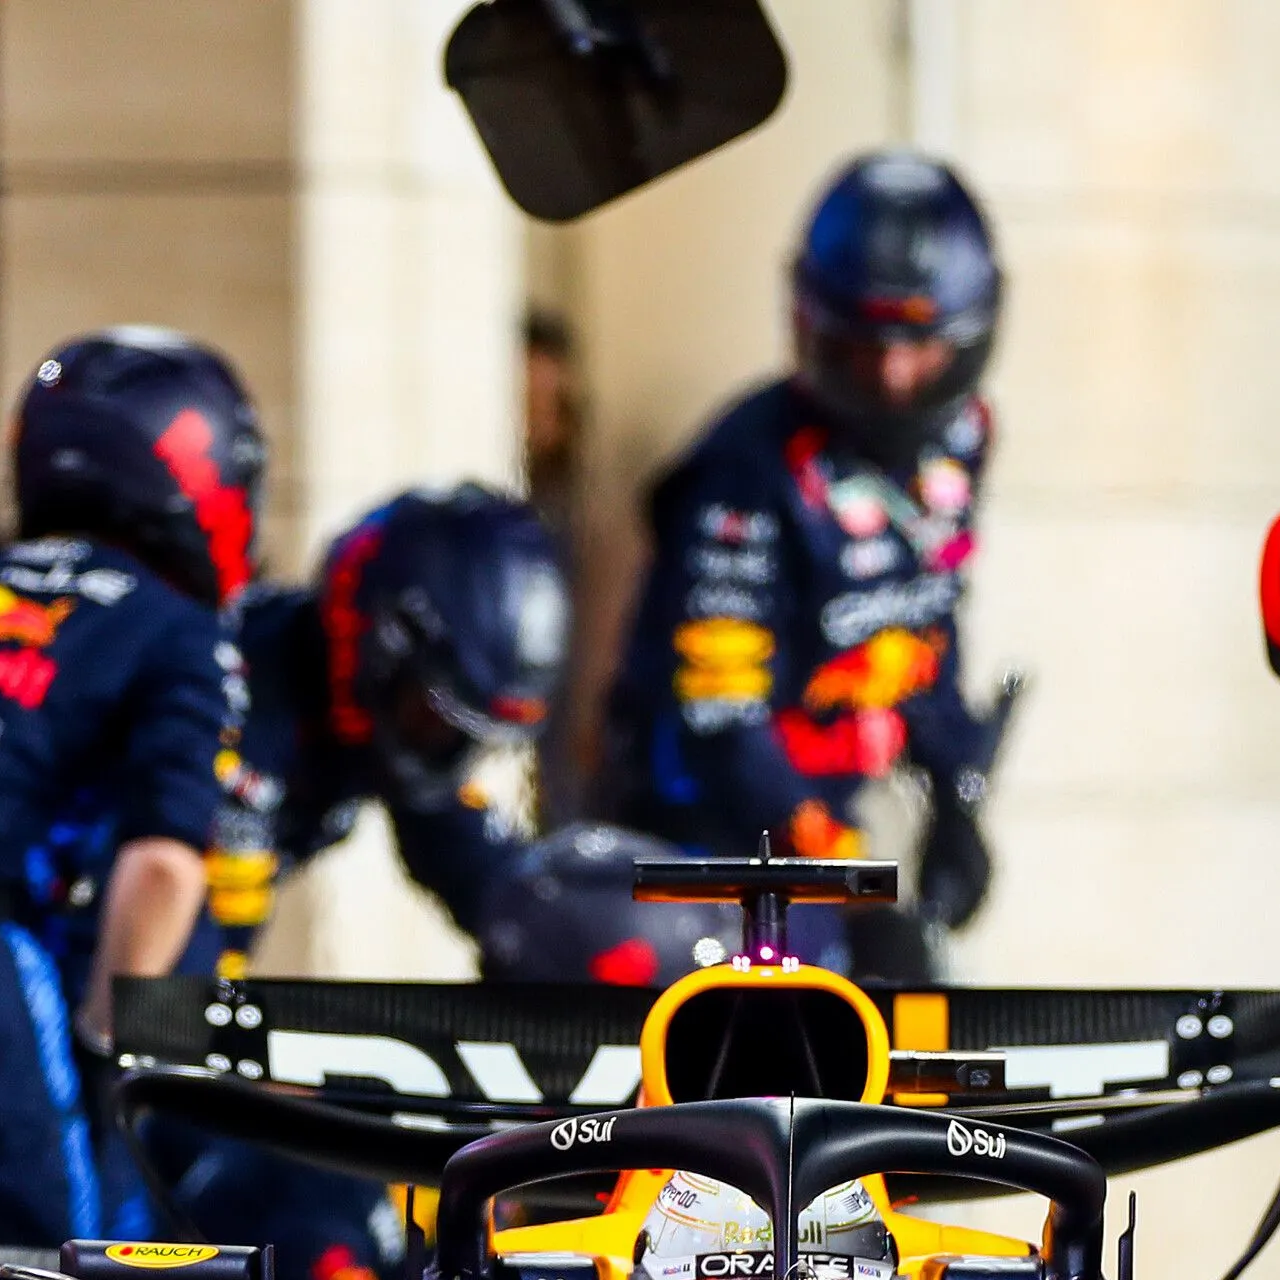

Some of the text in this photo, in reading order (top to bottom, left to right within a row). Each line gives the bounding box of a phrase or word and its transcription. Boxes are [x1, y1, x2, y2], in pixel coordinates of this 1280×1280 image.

[577, 1115, 618, 1144] Sui
[973, 1130, 1006, 1160] Sui
[798, 1221, 823, 1245] ull
[135, 1247, 204, 1257] RAUCH
[700, 1253, 849, 1279] ORALE
